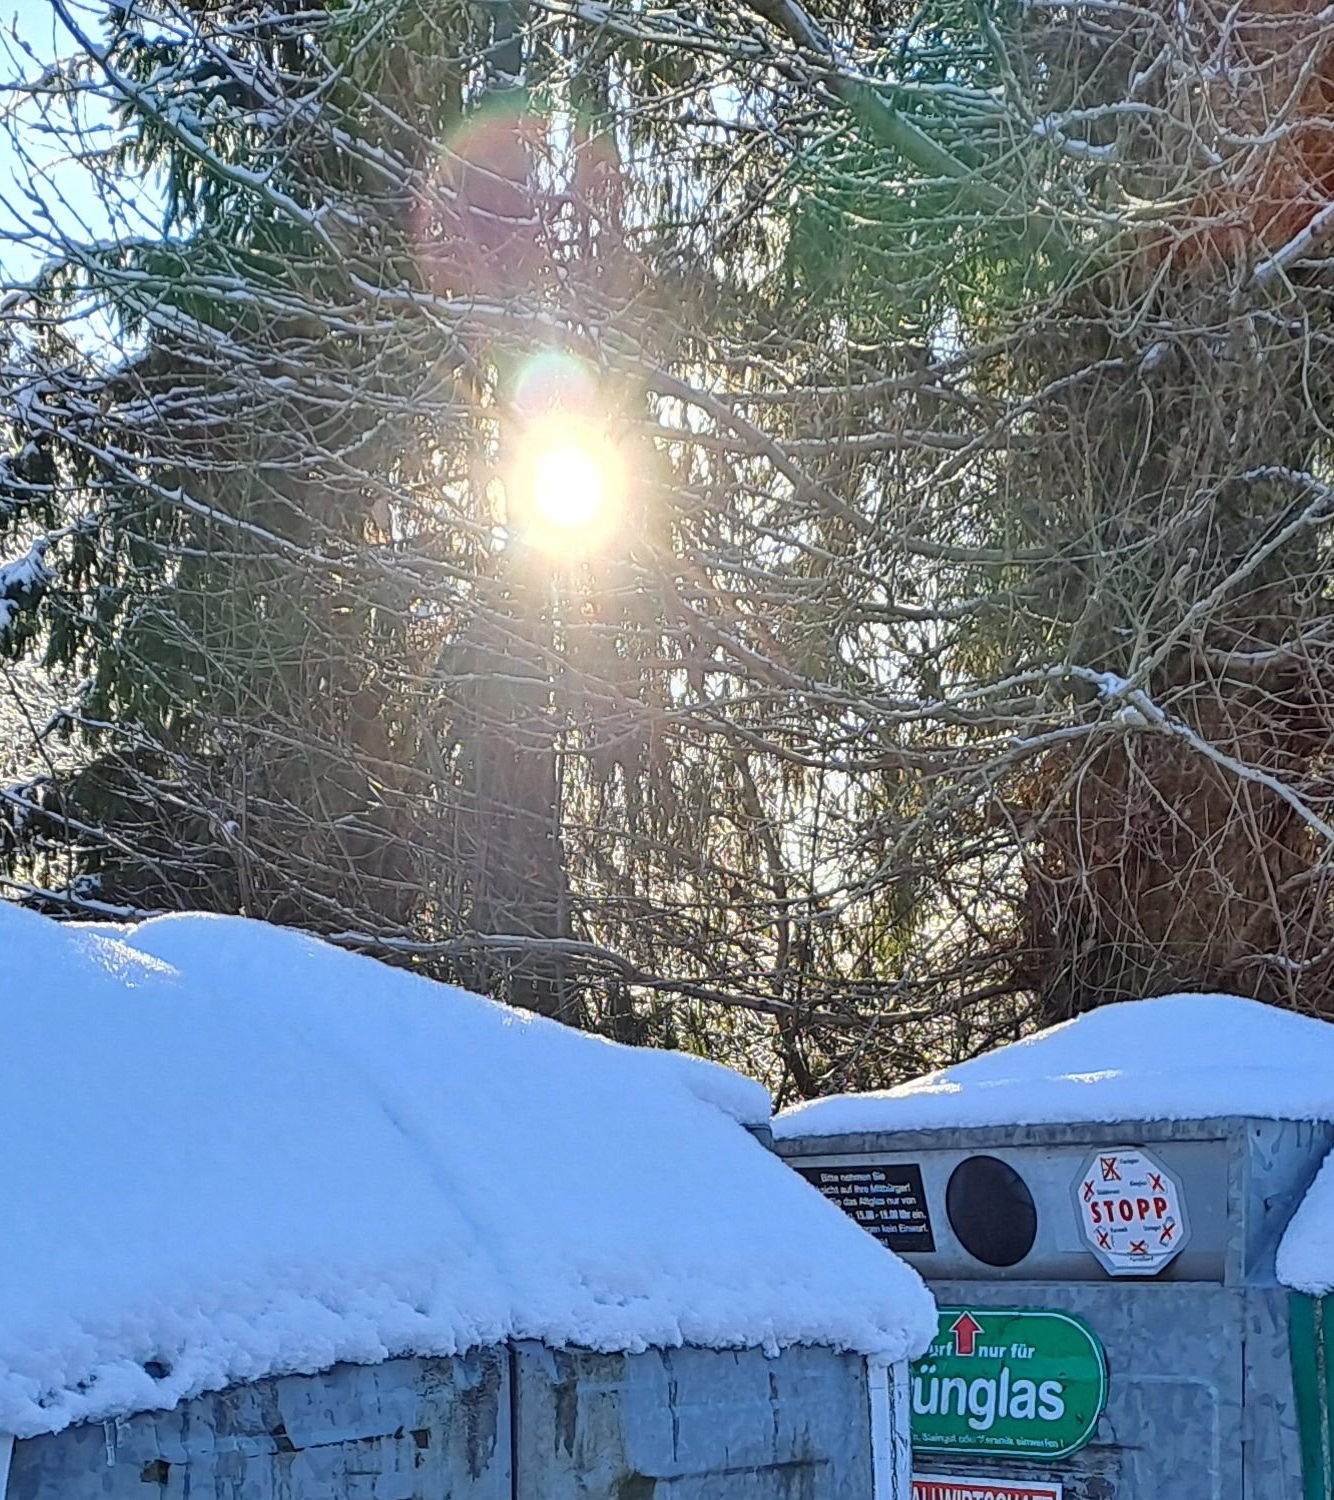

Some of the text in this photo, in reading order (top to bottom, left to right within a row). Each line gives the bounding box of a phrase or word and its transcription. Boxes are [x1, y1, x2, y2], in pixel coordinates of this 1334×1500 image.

[901, 1197, 917, 1205] von
[1091, 1197, 1167, 1223] STOPP
[978, 1346, 1006, 1359] nur
[1010, 1343, 1035, 1359] für
[911, 1364, 1065, 1431] ünglas
